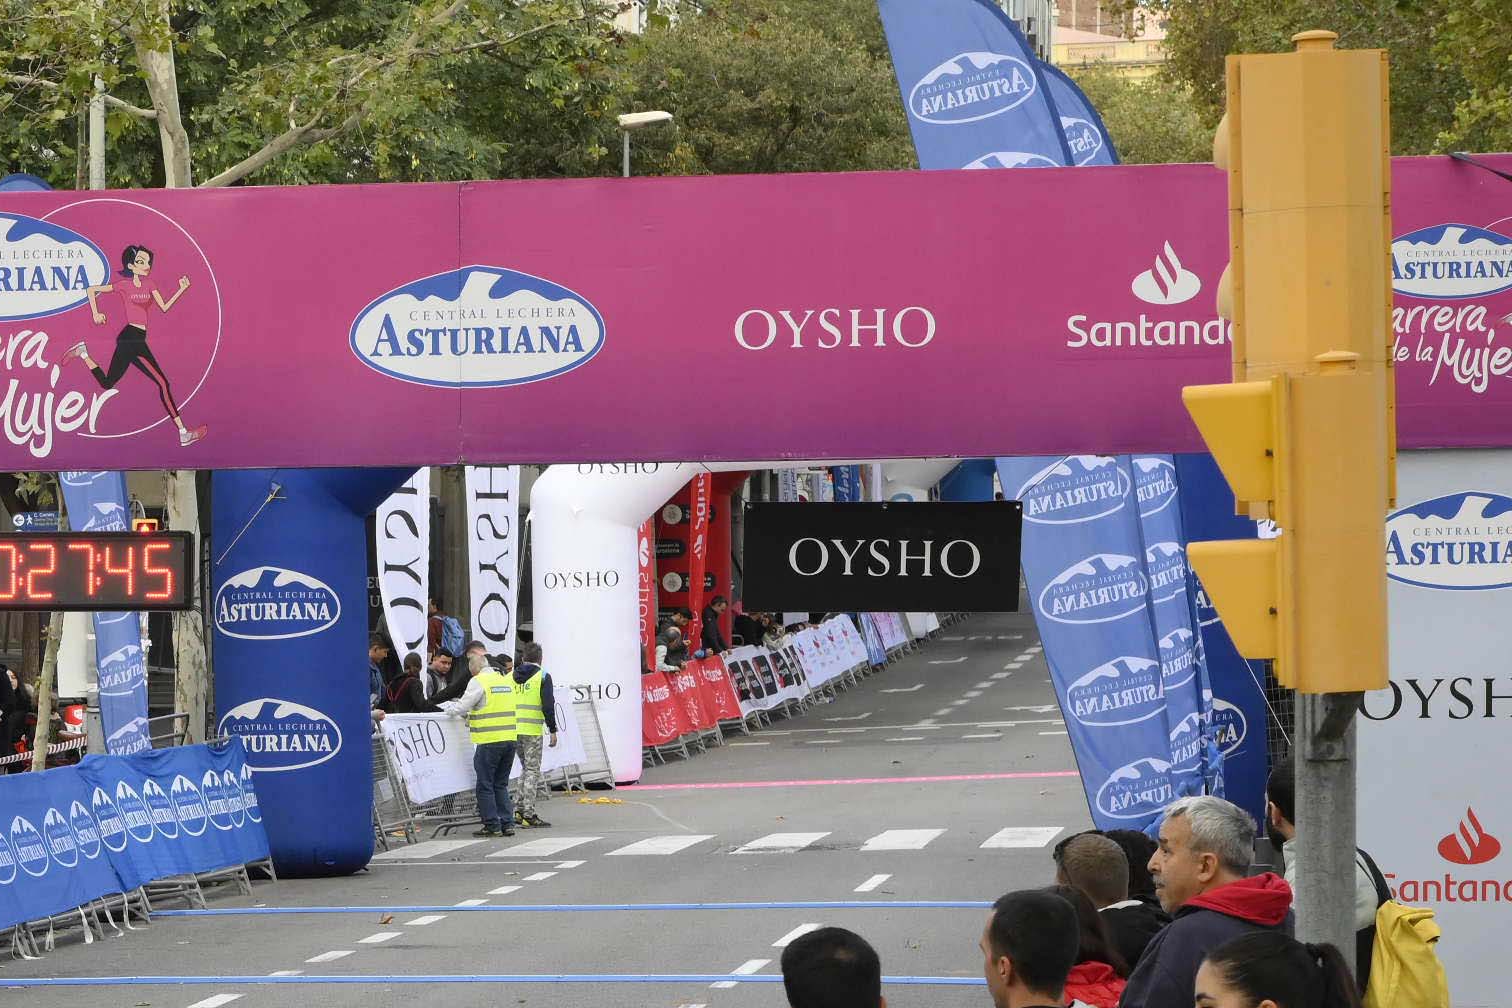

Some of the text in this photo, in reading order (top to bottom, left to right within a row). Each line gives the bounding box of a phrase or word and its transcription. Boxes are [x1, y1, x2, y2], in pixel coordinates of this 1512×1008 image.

[12, 248, 85, 261] LECHERA
[1406, 249, 1458, 258] CENTRAL
[409, 306, 576, 321] CENTRAL LECHERA
[733, 305, 937, 351] OYSHO
[1392, 304, 1488, 334] arrera
[369, 312, 585, 357] ASTURIANA
[1066, 313, 1231, 348] Santand
[1428, 328, 1512, 394] Muje
[1412, 526, 1480, 537] CENTRAL
[788, 537, 982, 579] OYSHO
[1386, 528, 1512, 566] ASTURIA
[543, 569, 619, 591] OYSHO
[218, 595, 332, 624] ASTURIANA
[231, 591, 327, 600] CENTRAL LECHERA
[573, 682, 621, 701] SHO
[1358, 677, 1512, 720] OYSH
[232, 723, 328, 732] CENTRAL LECHERA
[240, 733, 332, 752] TURIANA
[386, 718, 447, 768] YSHO
